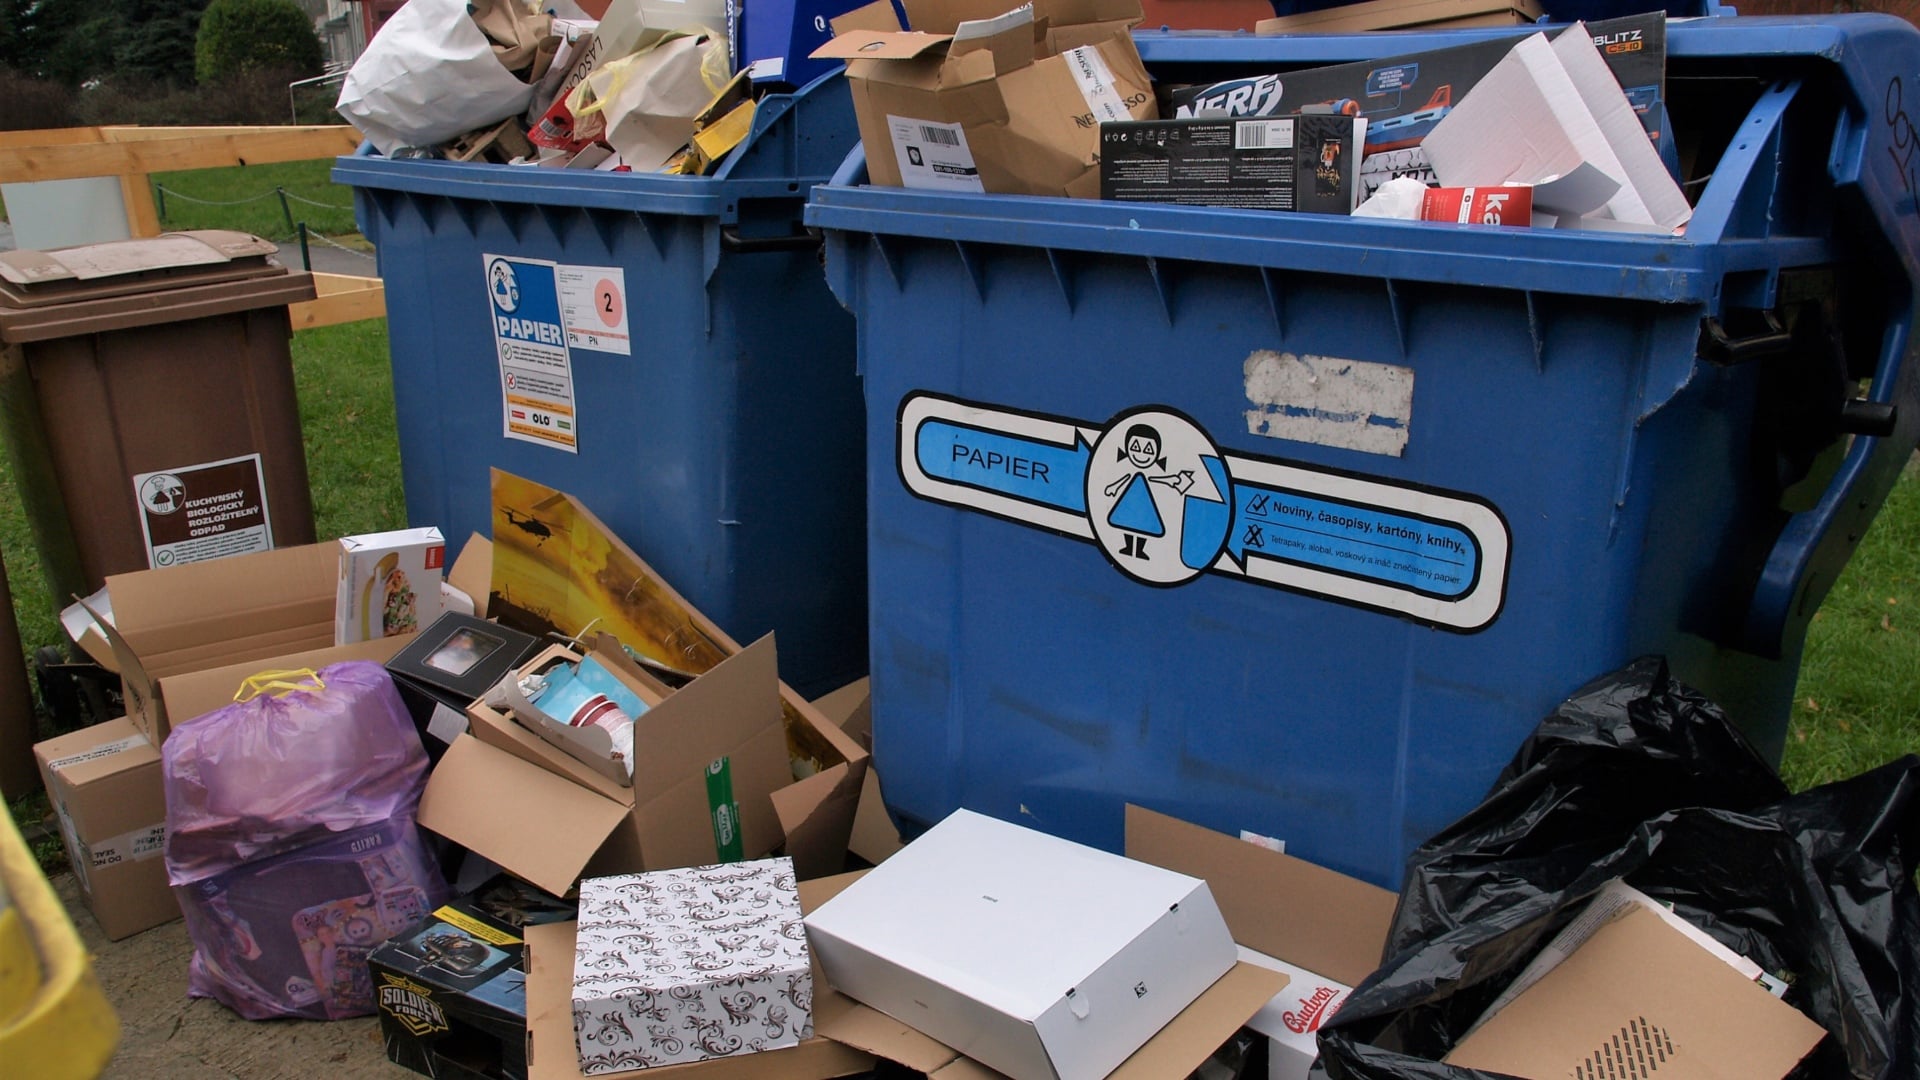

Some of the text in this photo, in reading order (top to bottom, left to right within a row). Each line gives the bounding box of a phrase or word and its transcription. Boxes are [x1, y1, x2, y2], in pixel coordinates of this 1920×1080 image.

[1594, 29, 1642, 46] BLITZ
[1176, 75, 1280, 119] NERF
[603, 293, 613, 312] 2
[498, 317, 563, 345] PAPIER
[569, 333, 599, 346] PN PN
[532, 413, 550, 426] OLO
[952, 444, 1049, 483] PAPIER
[185, 489, 244, 508] KUCHYNSKÝ
[187, 500, 245, 518] BIOLOGICKY
[190, 524, 226, 537] ODPAD
[1273, 502, 1315, 521] Noviny,
[1318, 510, 1373, 533] časopisy,
[1376, 523, 1423, 544] kartóny,
[1271, 535, 1306, 551] Tetrapaky,
[1335, 549, 1366, 564] voskový
[383, 988, 443, 1025] SOLDIER
[395, 1005, 433, 1025] FORCE
